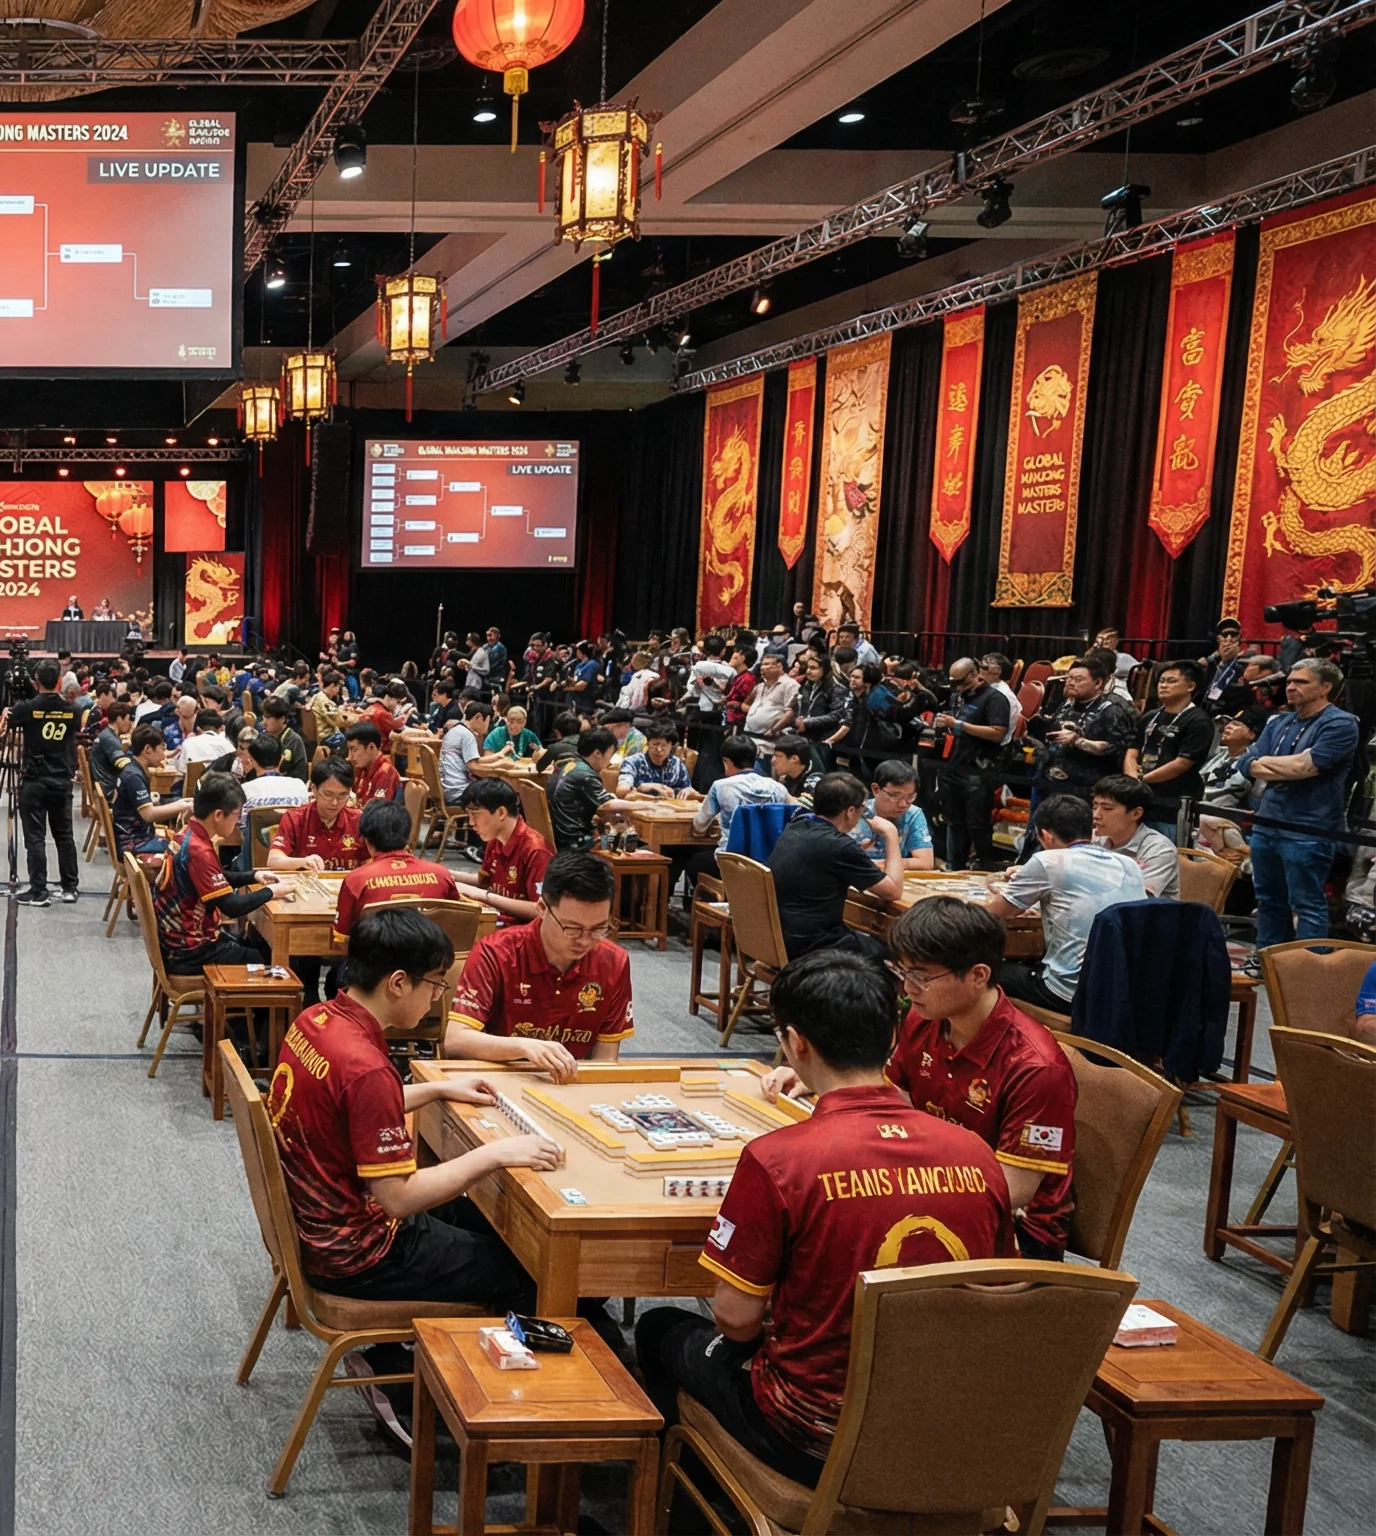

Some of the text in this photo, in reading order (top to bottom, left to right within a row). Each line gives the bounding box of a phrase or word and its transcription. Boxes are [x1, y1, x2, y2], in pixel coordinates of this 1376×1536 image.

[27, 124, 90, 141] MASTERS
[93, 124, 129, 141] 2024
[99, 162, 220, 178] LIVE UPDATE
